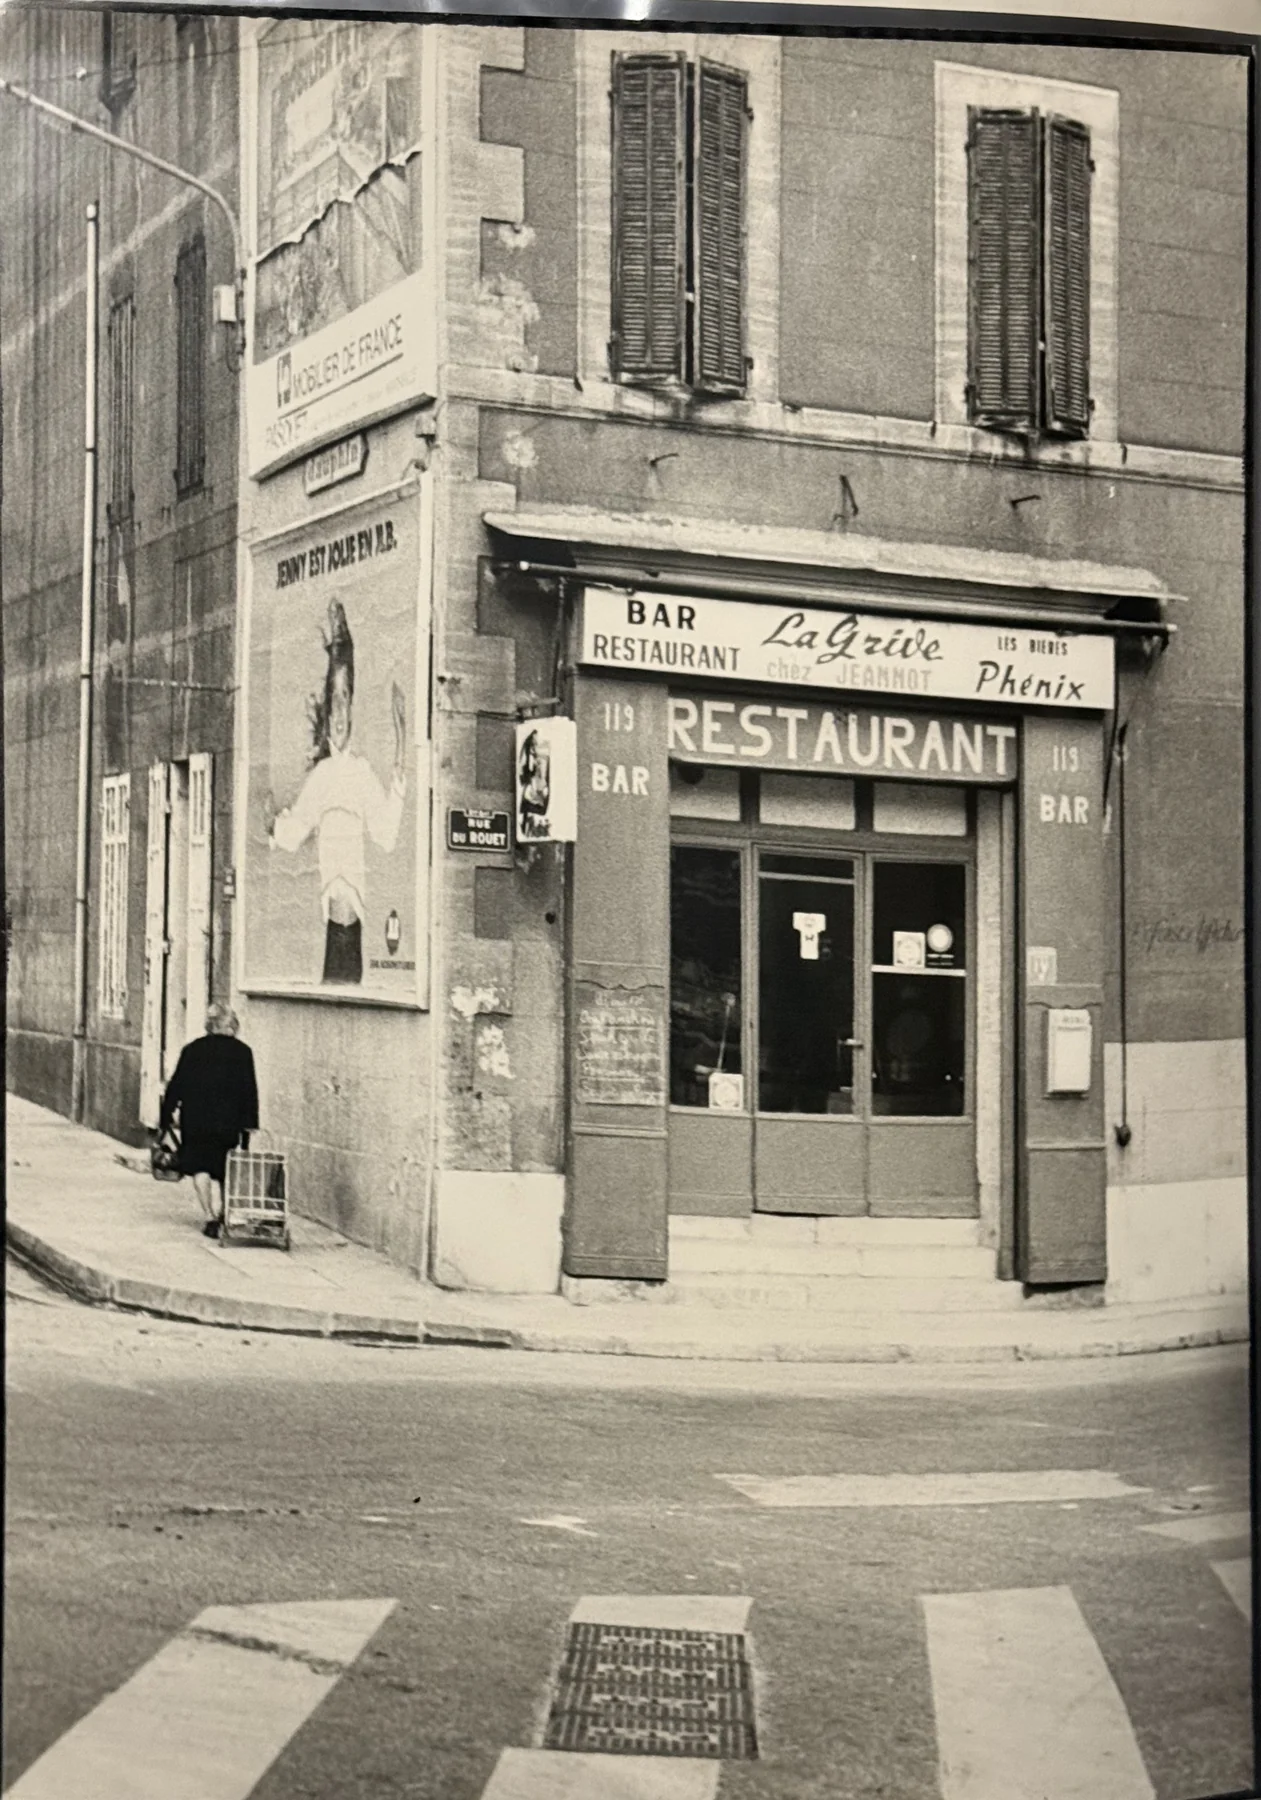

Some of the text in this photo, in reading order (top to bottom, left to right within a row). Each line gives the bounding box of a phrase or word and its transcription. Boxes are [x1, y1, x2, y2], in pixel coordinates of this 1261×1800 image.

[343, 341, 355, 375] DE
[309, 545, 325, 577] EST
[627, 600, 696, 630] BAR
[593, 633, 741, 672] RESTAURANT
[998, 636, 1017, 651] LES
[766, 656, 932, 691] chez JEANNOT
[603, 702, 635, 732] 119
[667, 697, 1016, 776] RESTAURANT
[591, 762, 651, 796] BAR
[467, 818, 492, 829] RUE
[1039, 793, 1089, 825] BAR
[470, 831, 507, 846] ROUET
